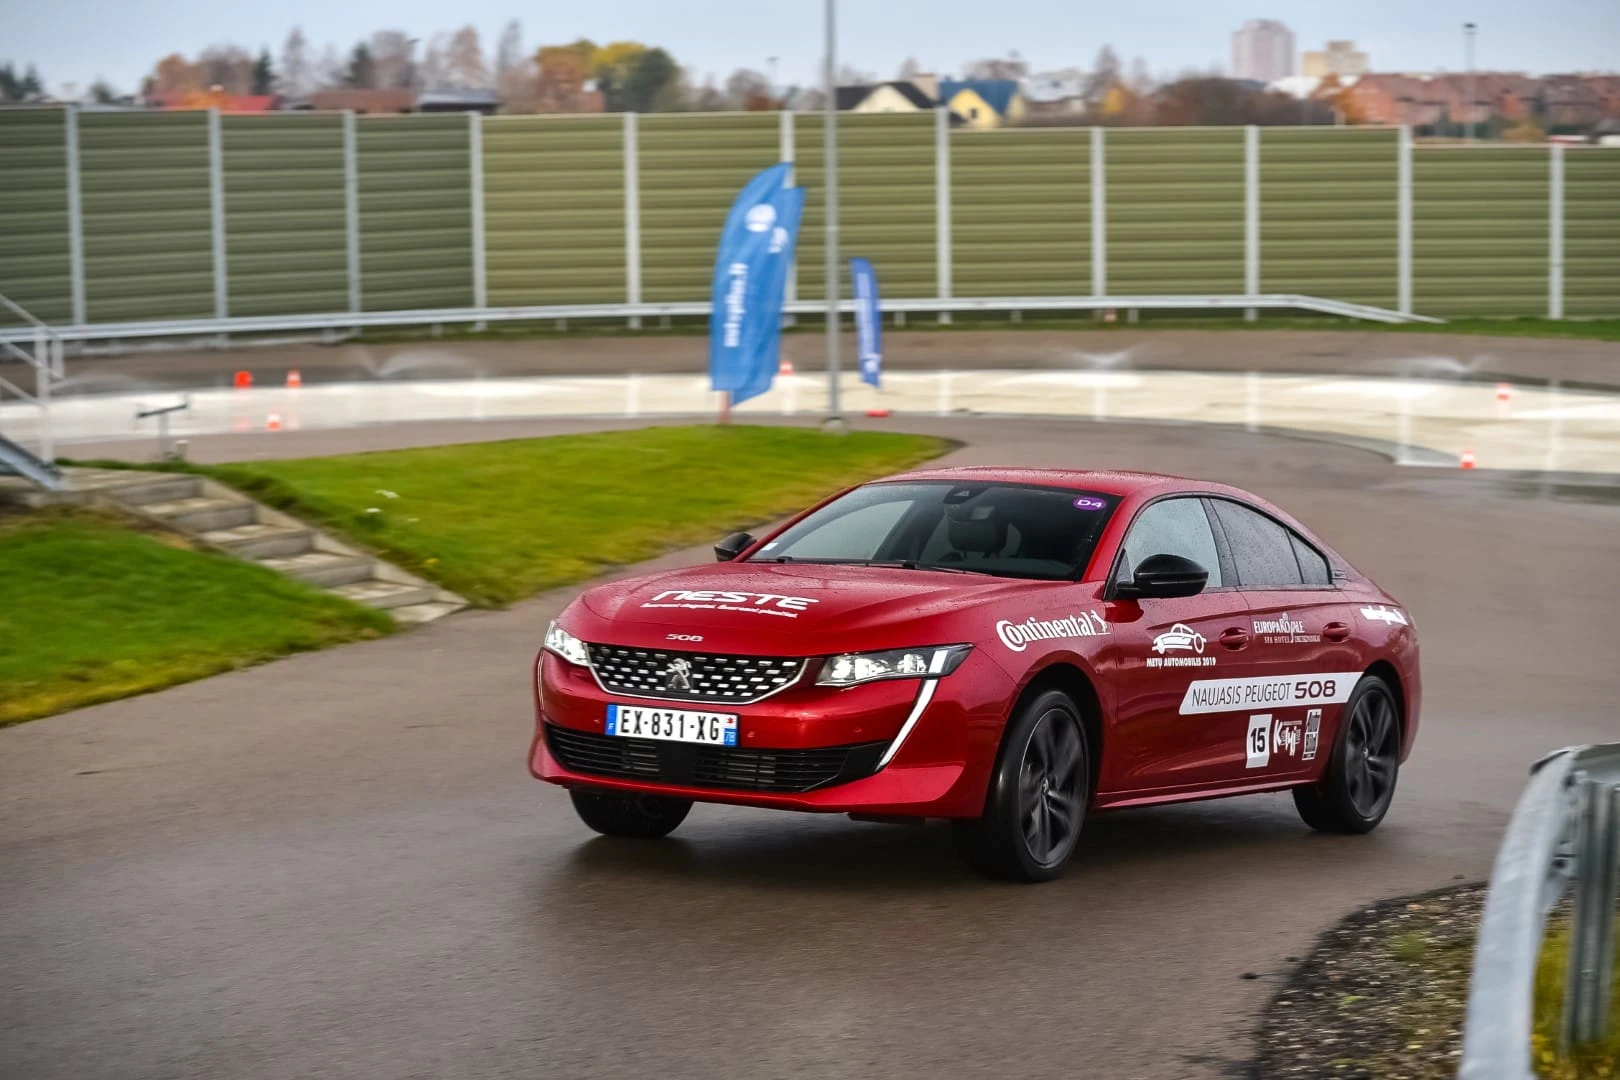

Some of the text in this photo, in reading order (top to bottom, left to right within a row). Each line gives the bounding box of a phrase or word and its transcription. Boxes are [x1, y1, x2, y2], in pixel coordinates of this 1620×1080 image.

[1077, 499, 1102, 508] D4
[650, 590, 819, 610] NESTE
[665, 633, 704, 642] 508
[996, 611, 1097, 652] Continental
[1163, 657, 1201, 667] AUTOMOBILIS
[1202, 656, 1216, 666] 2019
[1191, 679, 1337, 707] NAUJASIS PEUGEOT 508
[620, 709, 720, 741] EX-831-XG
[1250, 726, 1266, 754] 15
